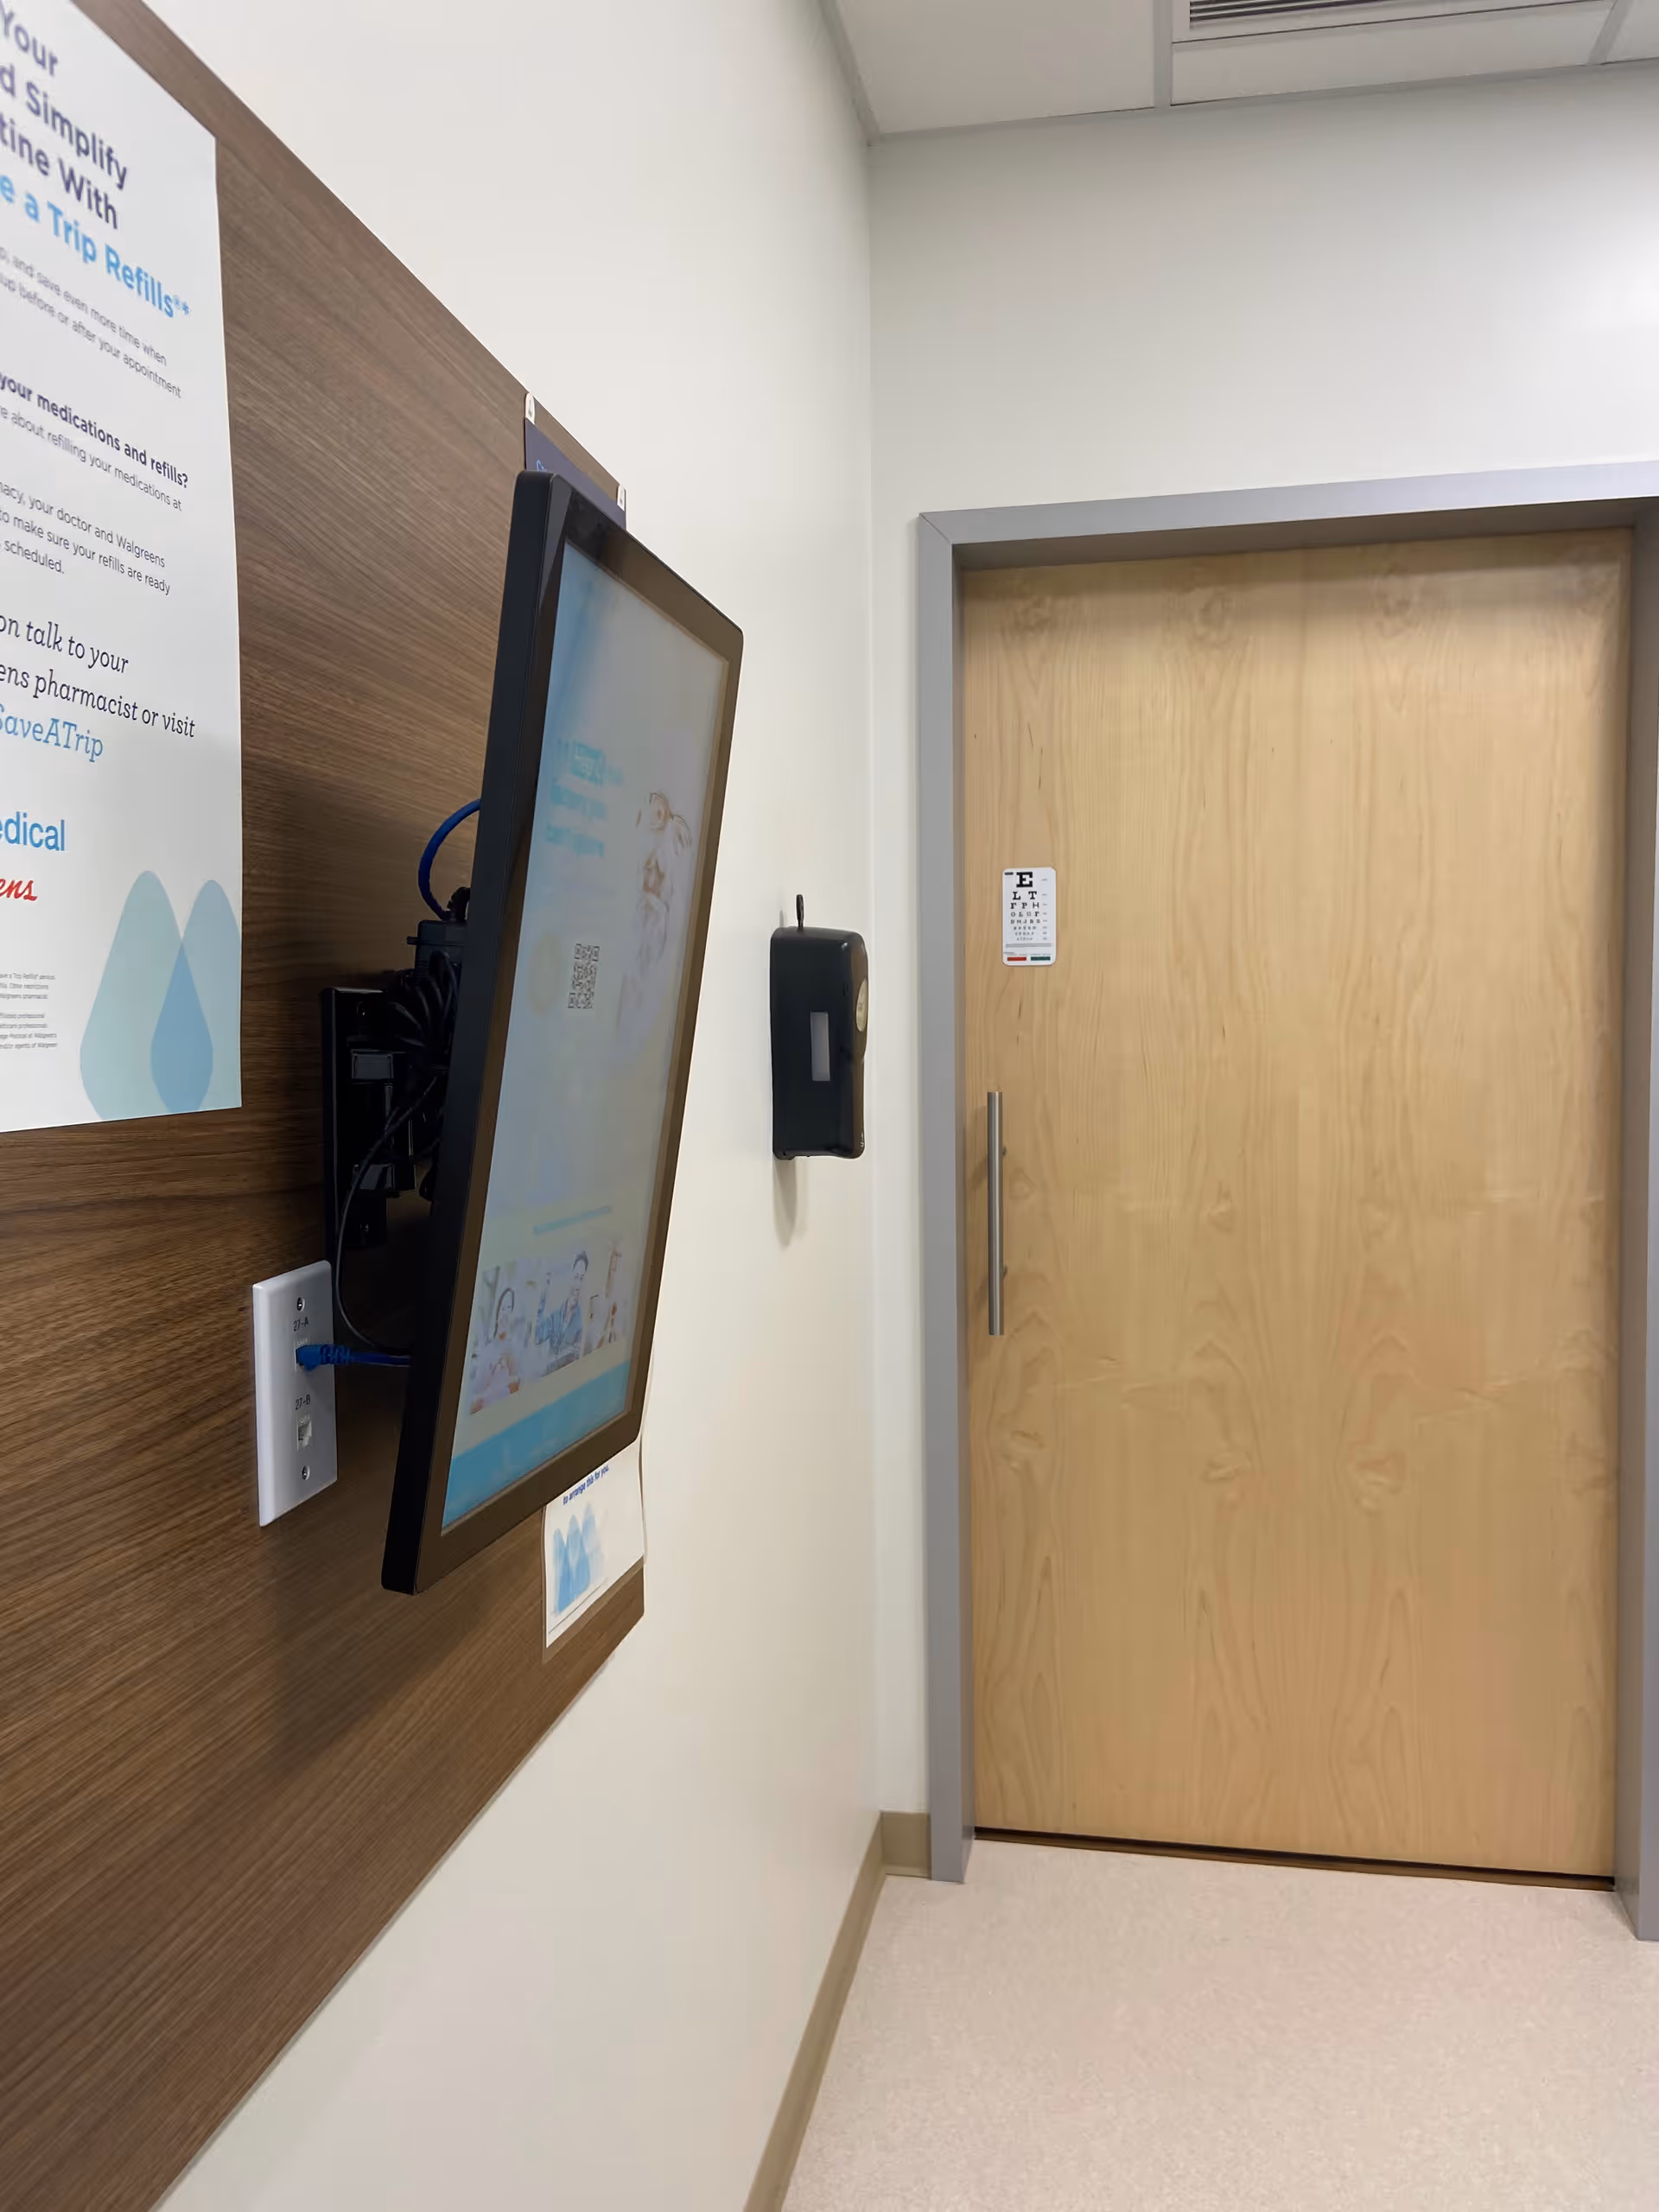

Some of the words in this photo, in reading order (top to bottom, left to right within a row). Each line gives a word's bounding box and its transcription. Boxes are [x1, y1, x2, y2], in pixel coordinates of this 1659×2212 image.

[0, 0, 58, 76] Your
[0, 113, 50, 176] tine
[59, 157, 118, 229] With
[26, 81, 127, 190] Simplify
[24, 191, 39, 223] a
[48, 200, 96, 264] Trip
[12, 256, 34, 277] and
[36, 271, 61, 296] save
[63, 289, 88, 315] even
[91, 308, 117, 333] more
[118, 325, 140, 348] time
[142, 343, 167, 366] when
[18, 283, 55, 317] before
[57, 312, 69, 326] or
[72, 320, 96, 343] after
[98, 337, 121, 359] your
[124, 353, 181, 398] appointment
[0, 372, 32, 402] your
[37, 393, 121, 453] medications
[124, 441, 148, 467] and
[150, 455, 188, 489] refills?
[11, 410, 45, 439] about
[47, 429, 87, 463] refilling
[89, 452, 112, 474] your
[114, 464, 171, 506] medications
[173, 497, 182, 512] at
[4, 537, 65, 575] scheduled.
[14, 515, 44, 538] make
[47, 530, 70, 550] sure
[73, 541, 96, 562] your
[99, 550, 125, 575] refills
[127, 565, 143, 582] are
[144, 569, 171, 596] ready
[29, 494, 54, 516] your
[56, 507, 92, 534] doctor
[95, 525, 114, 544] and
[117, 534, 166, 568] Walgreens
[0, 614, 20, 638] on
[26, 621, 63, 652] talk
[68, 636, 86, 658] to
[87, 646, 129, 674] your
[0, 664, 29, 690] ens
[33, 669, 138, 721] pharmacist
[142, 709, 159, 728] or
[162, 712, 195, 738] visit
[1012, 891, 1021, 900] L
[1028, 891, 1037, 899] T
[1016, 872, 1033, 887] E
[293, 1316, 309, 1332] 27-A
[296, 1394, 311, 1411] 27-B
